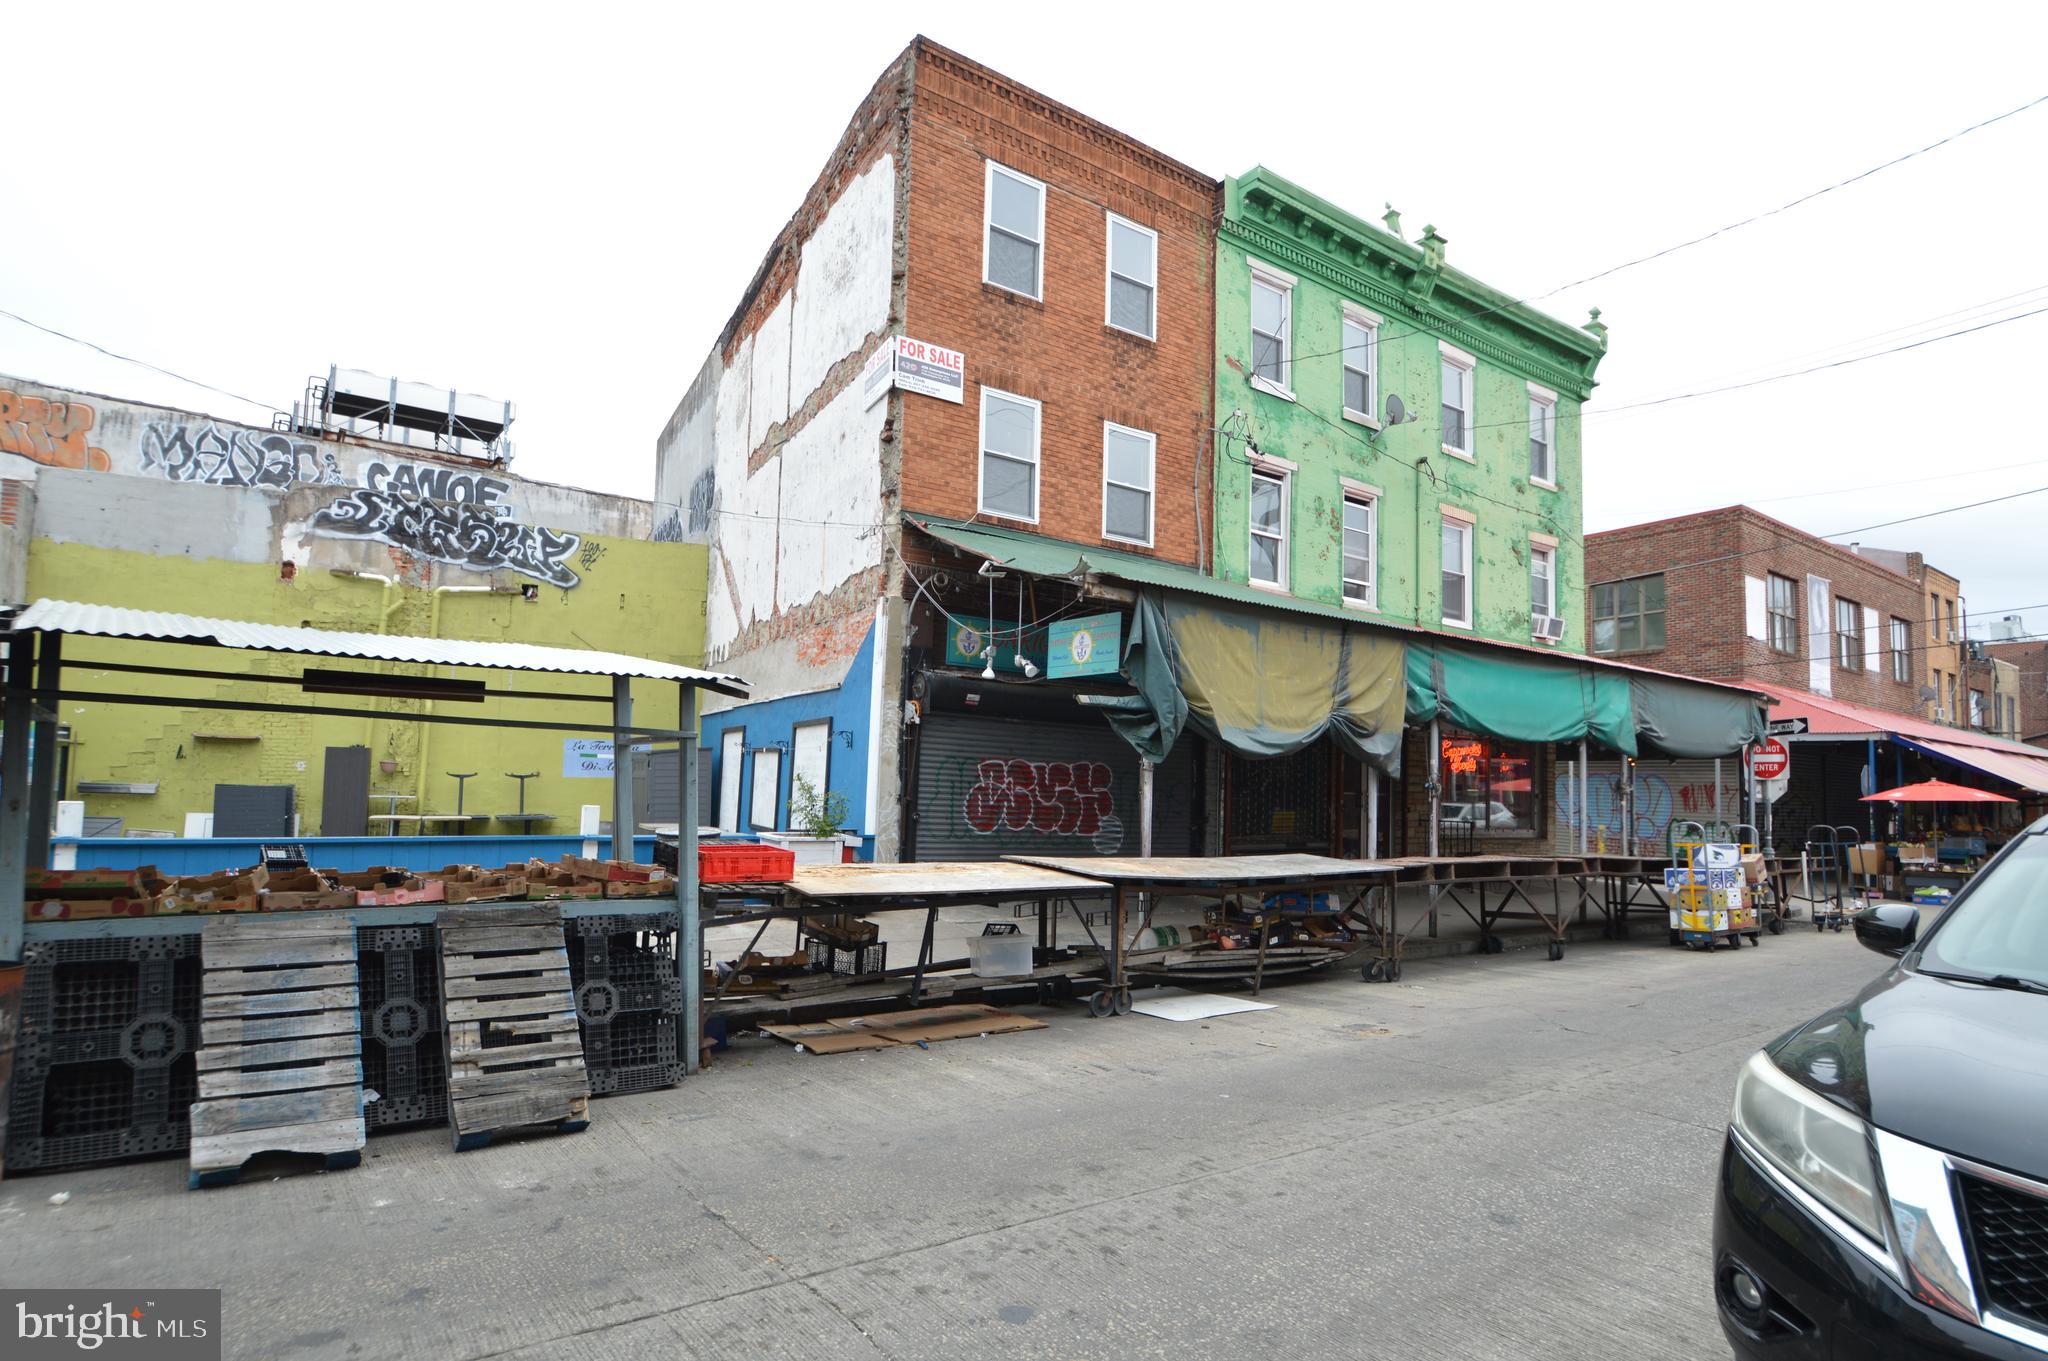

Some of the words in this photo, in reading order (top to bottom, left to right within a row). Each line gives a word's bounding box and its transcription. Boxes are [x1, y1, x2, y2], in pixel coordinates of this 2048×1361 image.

[899, 339, 925, 360] FOR
[929, 347, 961, 370] SALE
[1781, 722, 1794, 732] WAY
[1766, 744, 1780, 753] NOT
[1754, 763, 1779, 772] ENTER
